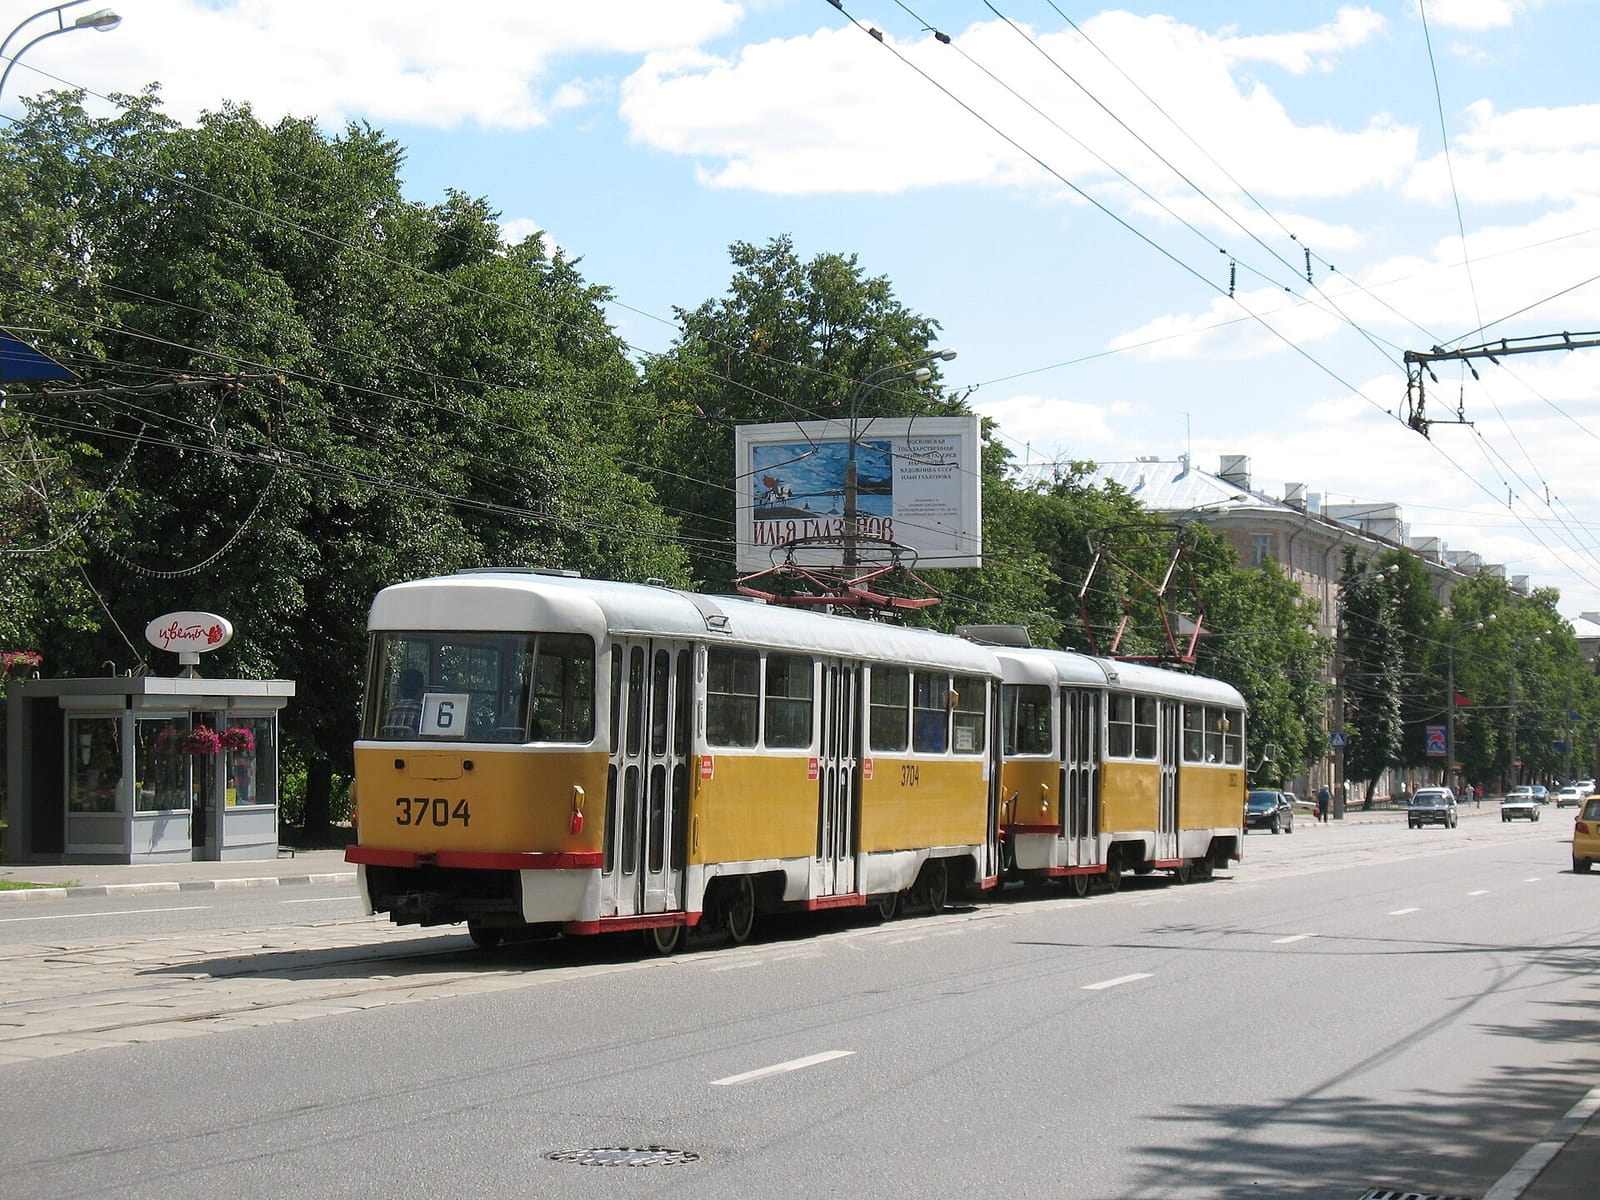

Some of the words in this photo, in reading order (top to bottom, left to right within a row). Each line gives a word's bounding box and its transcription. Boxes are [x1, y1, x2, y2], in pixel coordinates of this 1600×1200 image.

[752, 520, 797, 546] ИЛЬЯ
[802, 517, 894, 545] ГЛАЗНОВ
[437, 701, 455, 728] 6
[901, 764, 920, 787] 3704
[396, 797, 471, 827] 3704
